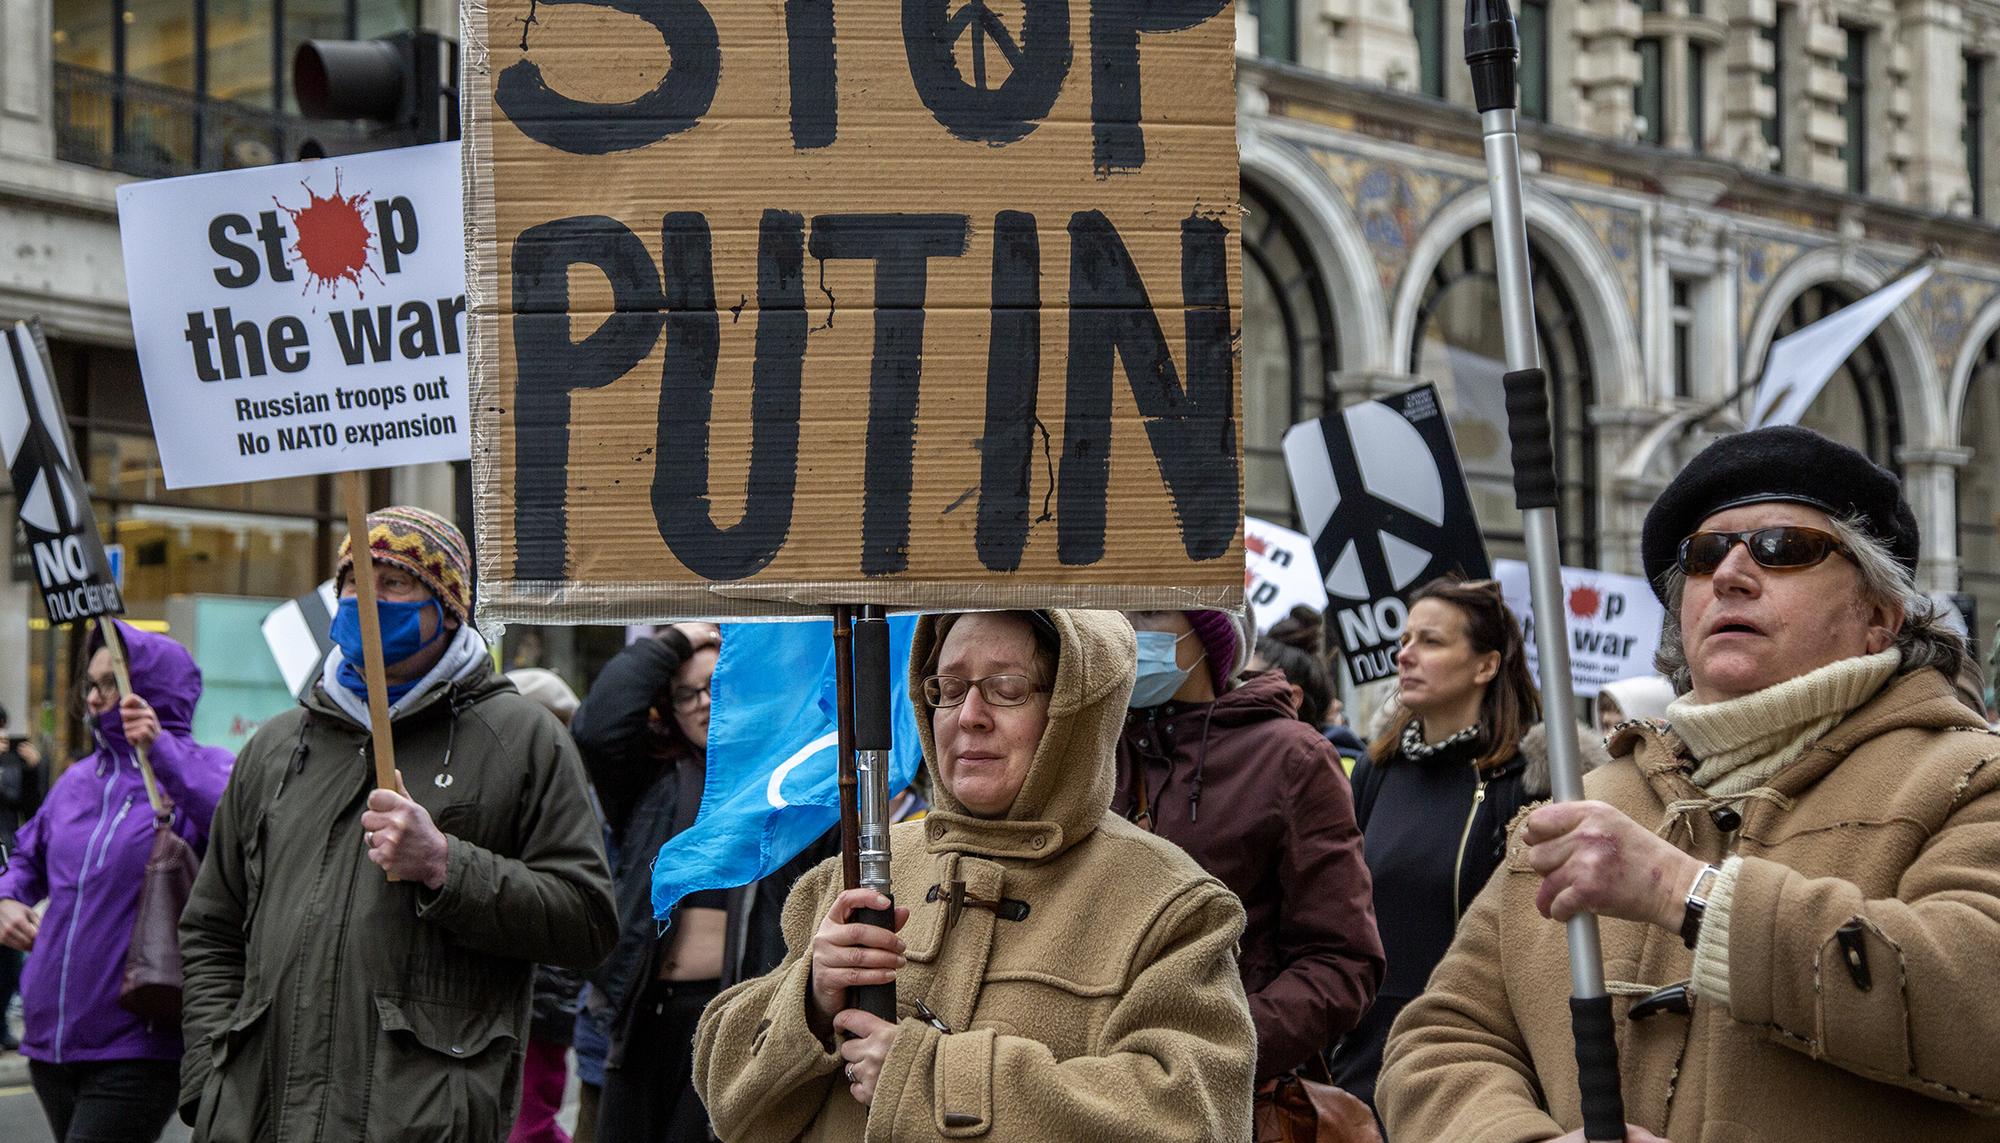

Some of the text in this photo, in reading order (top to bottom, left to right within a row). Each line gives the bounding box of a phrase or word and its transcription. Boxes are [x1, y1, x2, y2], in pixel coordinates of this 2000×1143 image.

[184, 294, 467, 383] the war
[235, 376, 450, 422] Russian troops out
[511, 208, 1241, 582] PUTIN
[237, 413, 458, 456] No NATO expansion
[33, 534, 89, 589] NO
[1337, 596, 1409, 652] NO
[1574, 627, 1638, 661] war
[1352, 643, 1403, 682] nuc
